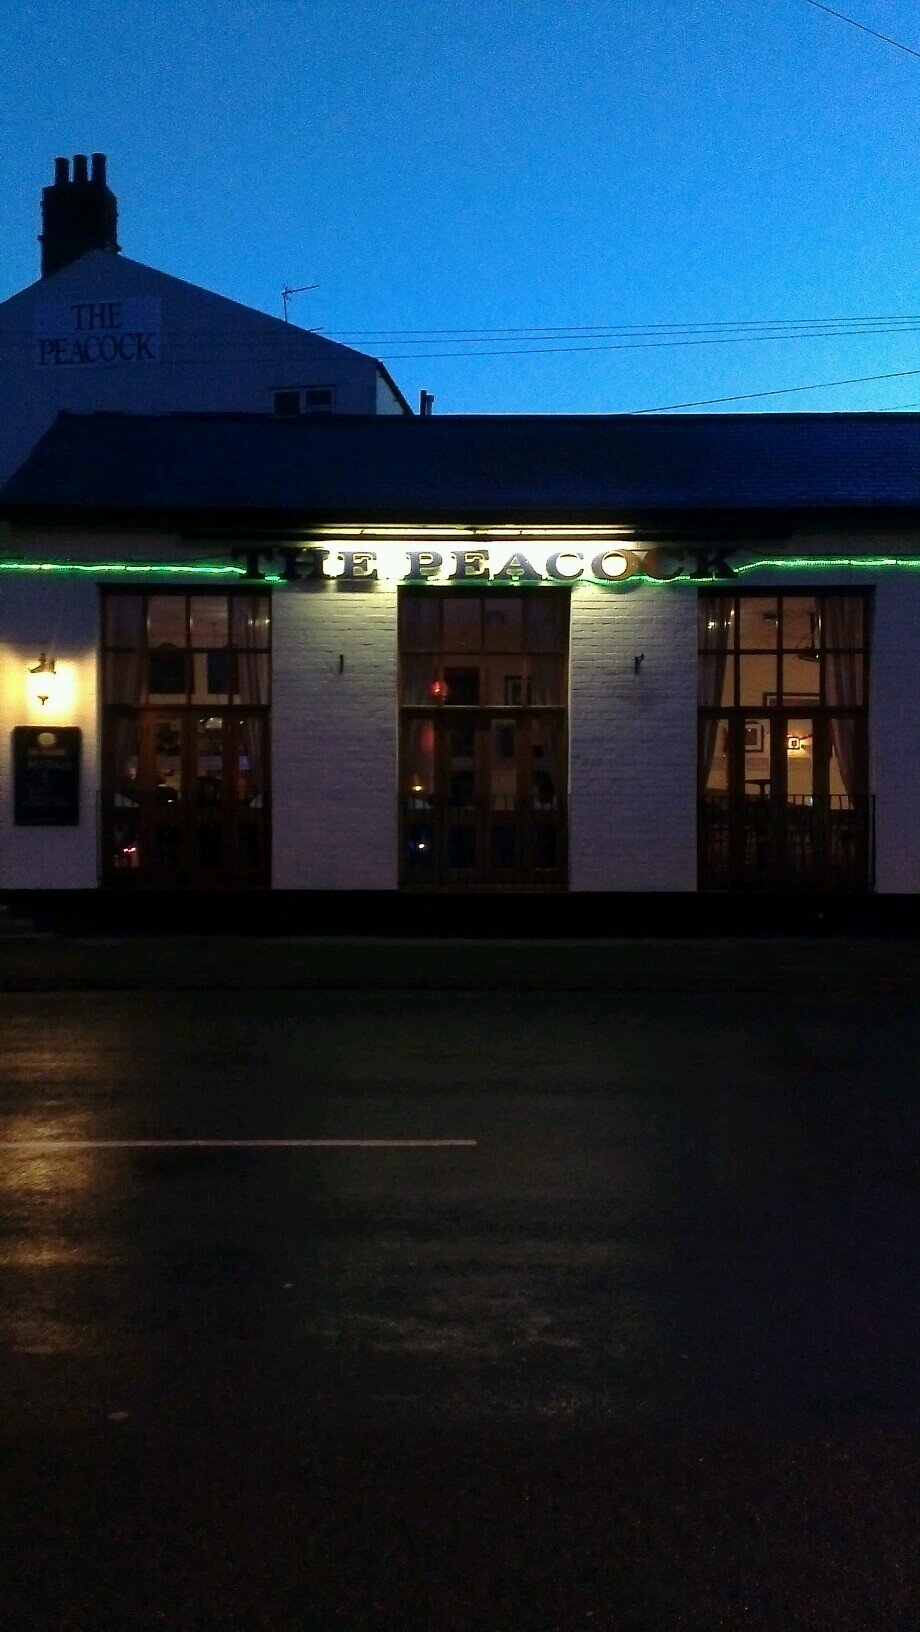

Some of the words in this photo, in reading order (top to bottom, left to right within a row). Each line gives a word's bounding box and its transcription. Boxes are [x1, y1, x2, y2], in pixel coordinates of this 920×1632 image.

[69, 303, 122, 331] THE
[39, 333, 155, 366] PEACOCK
[232, 546, 378, 580] THE
[404, 546, 738, 580] PEACOCK
